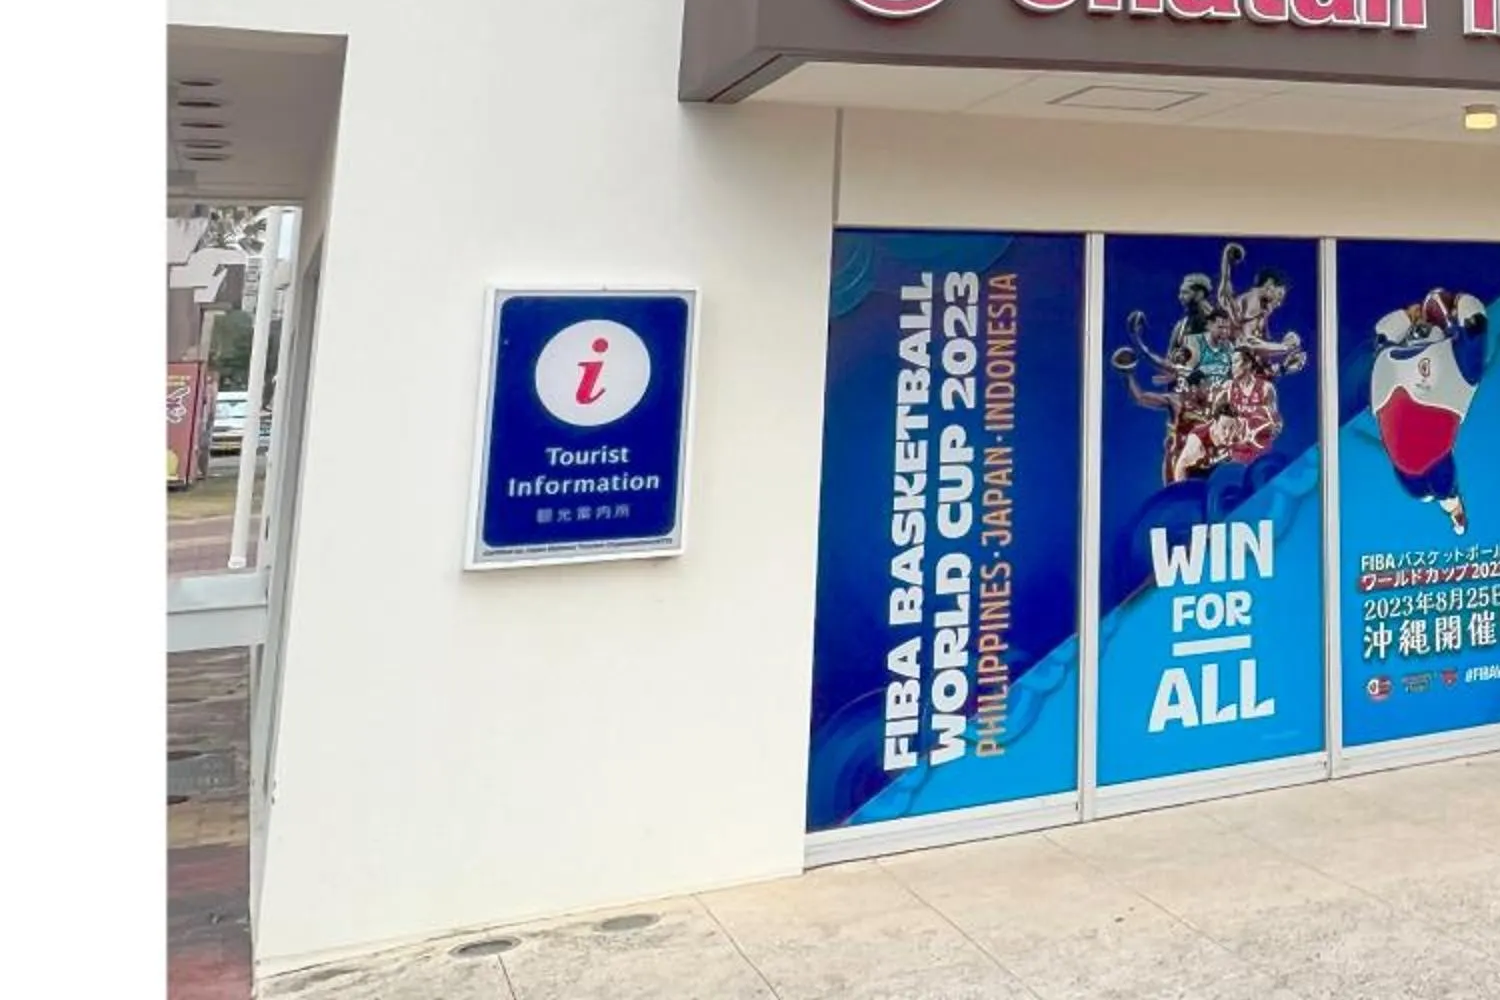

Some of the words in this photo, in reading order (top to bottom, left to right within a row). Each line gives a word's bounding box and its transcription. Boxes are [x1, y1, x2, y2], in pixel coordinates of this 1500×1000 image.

[941, 271, 980, 411] 2023
[508, 472, 660, 497] Information
[545, 445, 631, 467] Tourist
[889, 271, 934, 626] BASKETBALL
[937, 424, 975, 539] CUP
[1150, 519, 1273, 588] WIN
[1172, 590, 1253, 633] FOR
[884, 636, 923, 771] FIBA
[930, 552, 974, 767] WORLD
[1148, 659, 1275, 733] ALL
